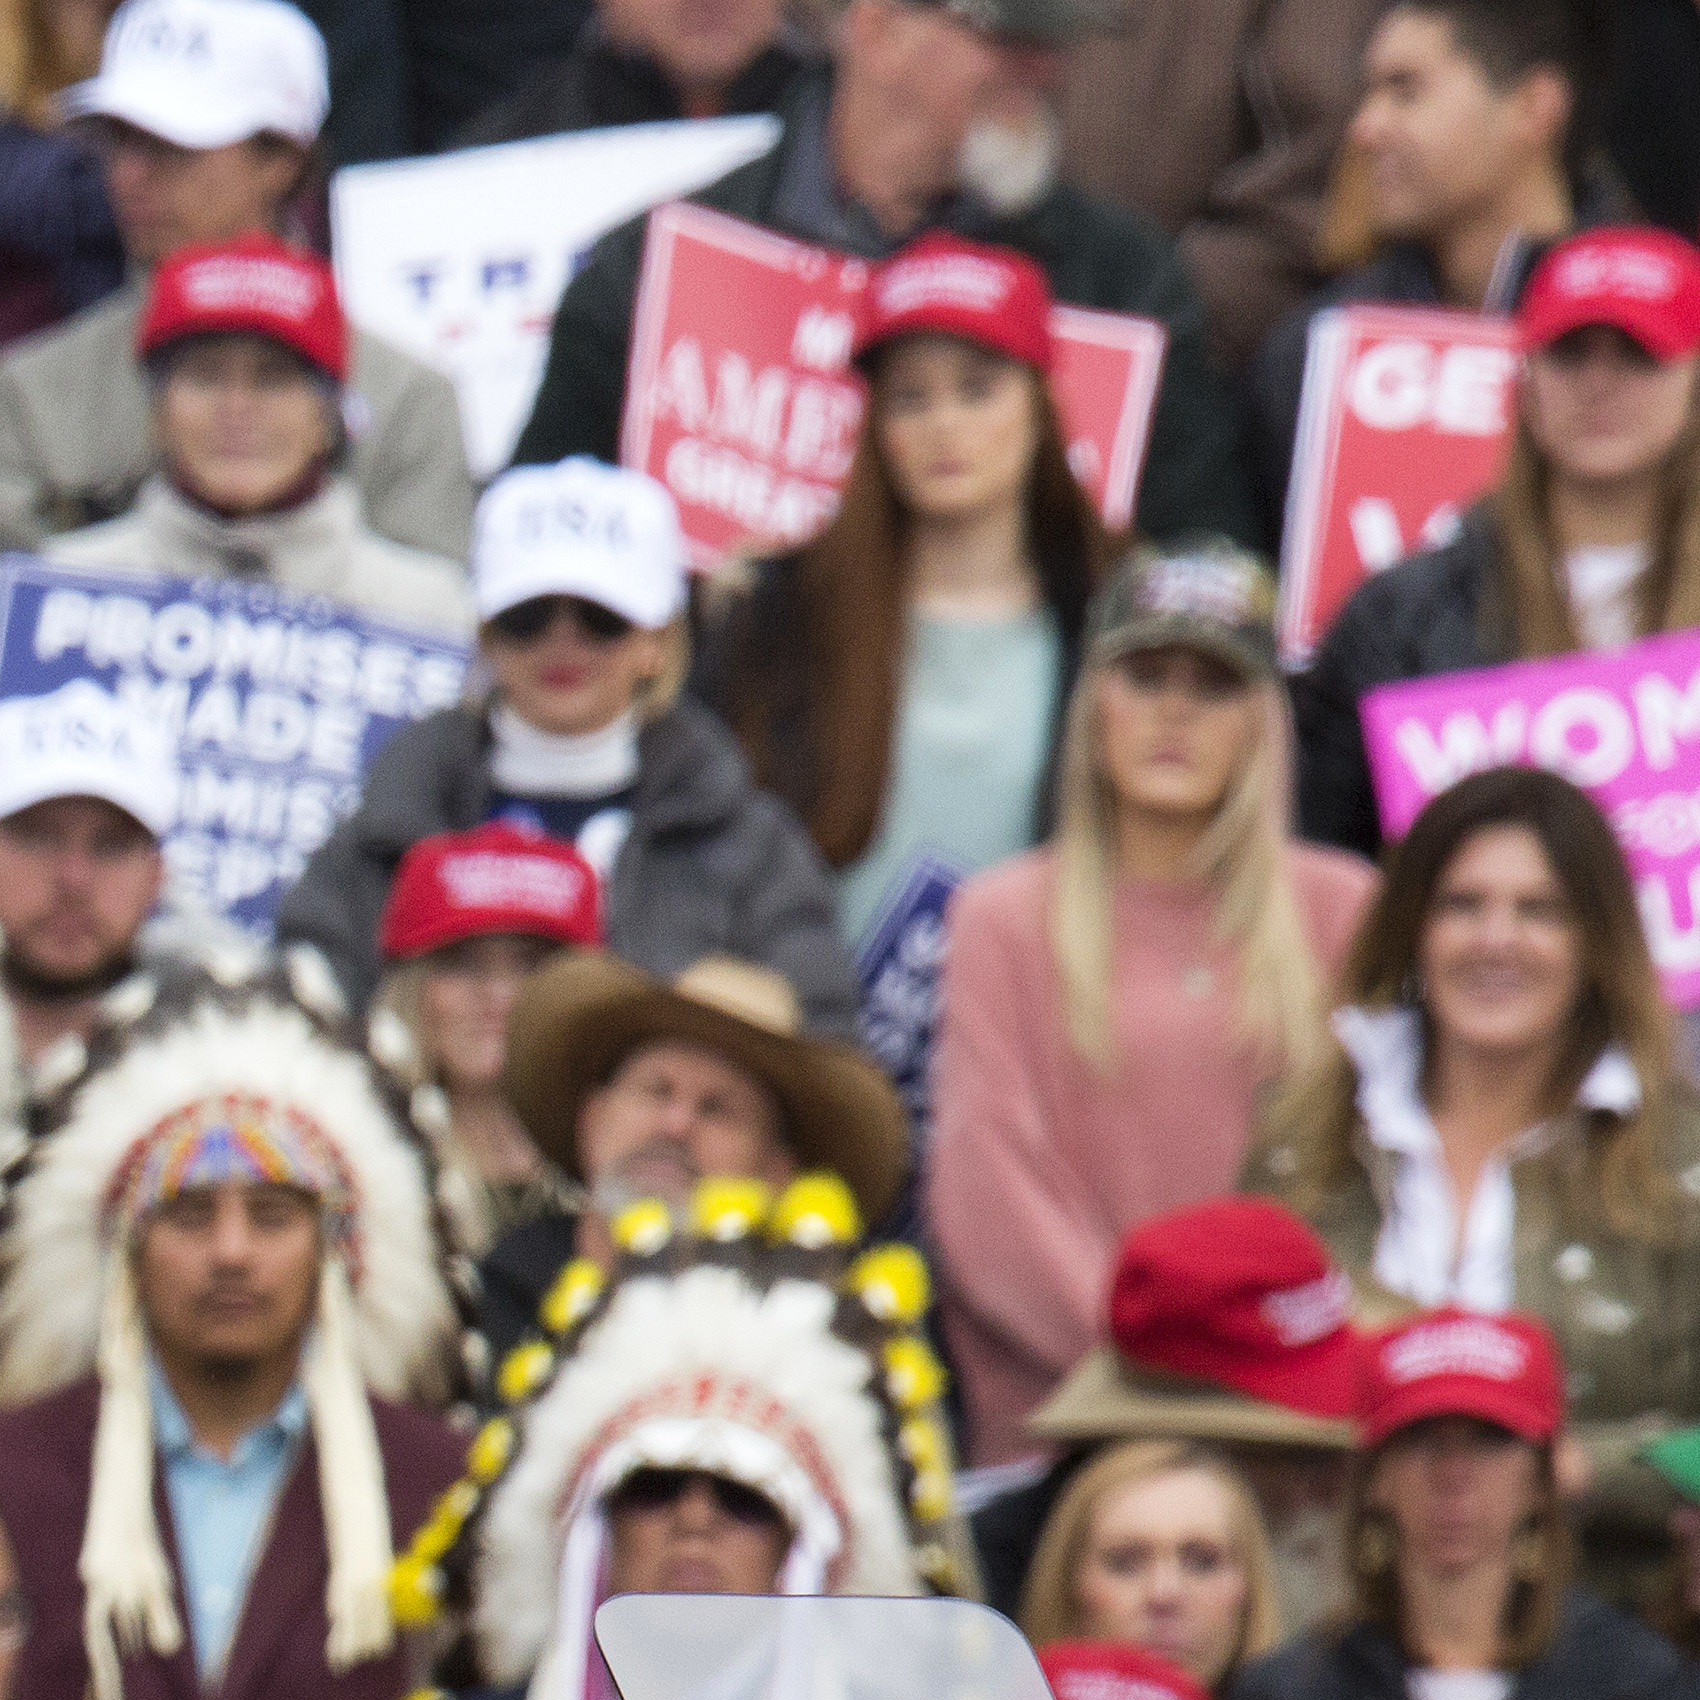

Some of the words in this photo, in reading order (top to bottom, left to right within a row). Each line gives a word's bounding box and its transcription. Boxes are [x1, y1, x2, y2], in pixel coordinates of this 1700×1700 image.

[1348, 342, 1512, 436] GE
[513, 498, 634, 554] USA
[34, 588, 467, 722] PROMISES
[18, 714, 138, 768] USA
